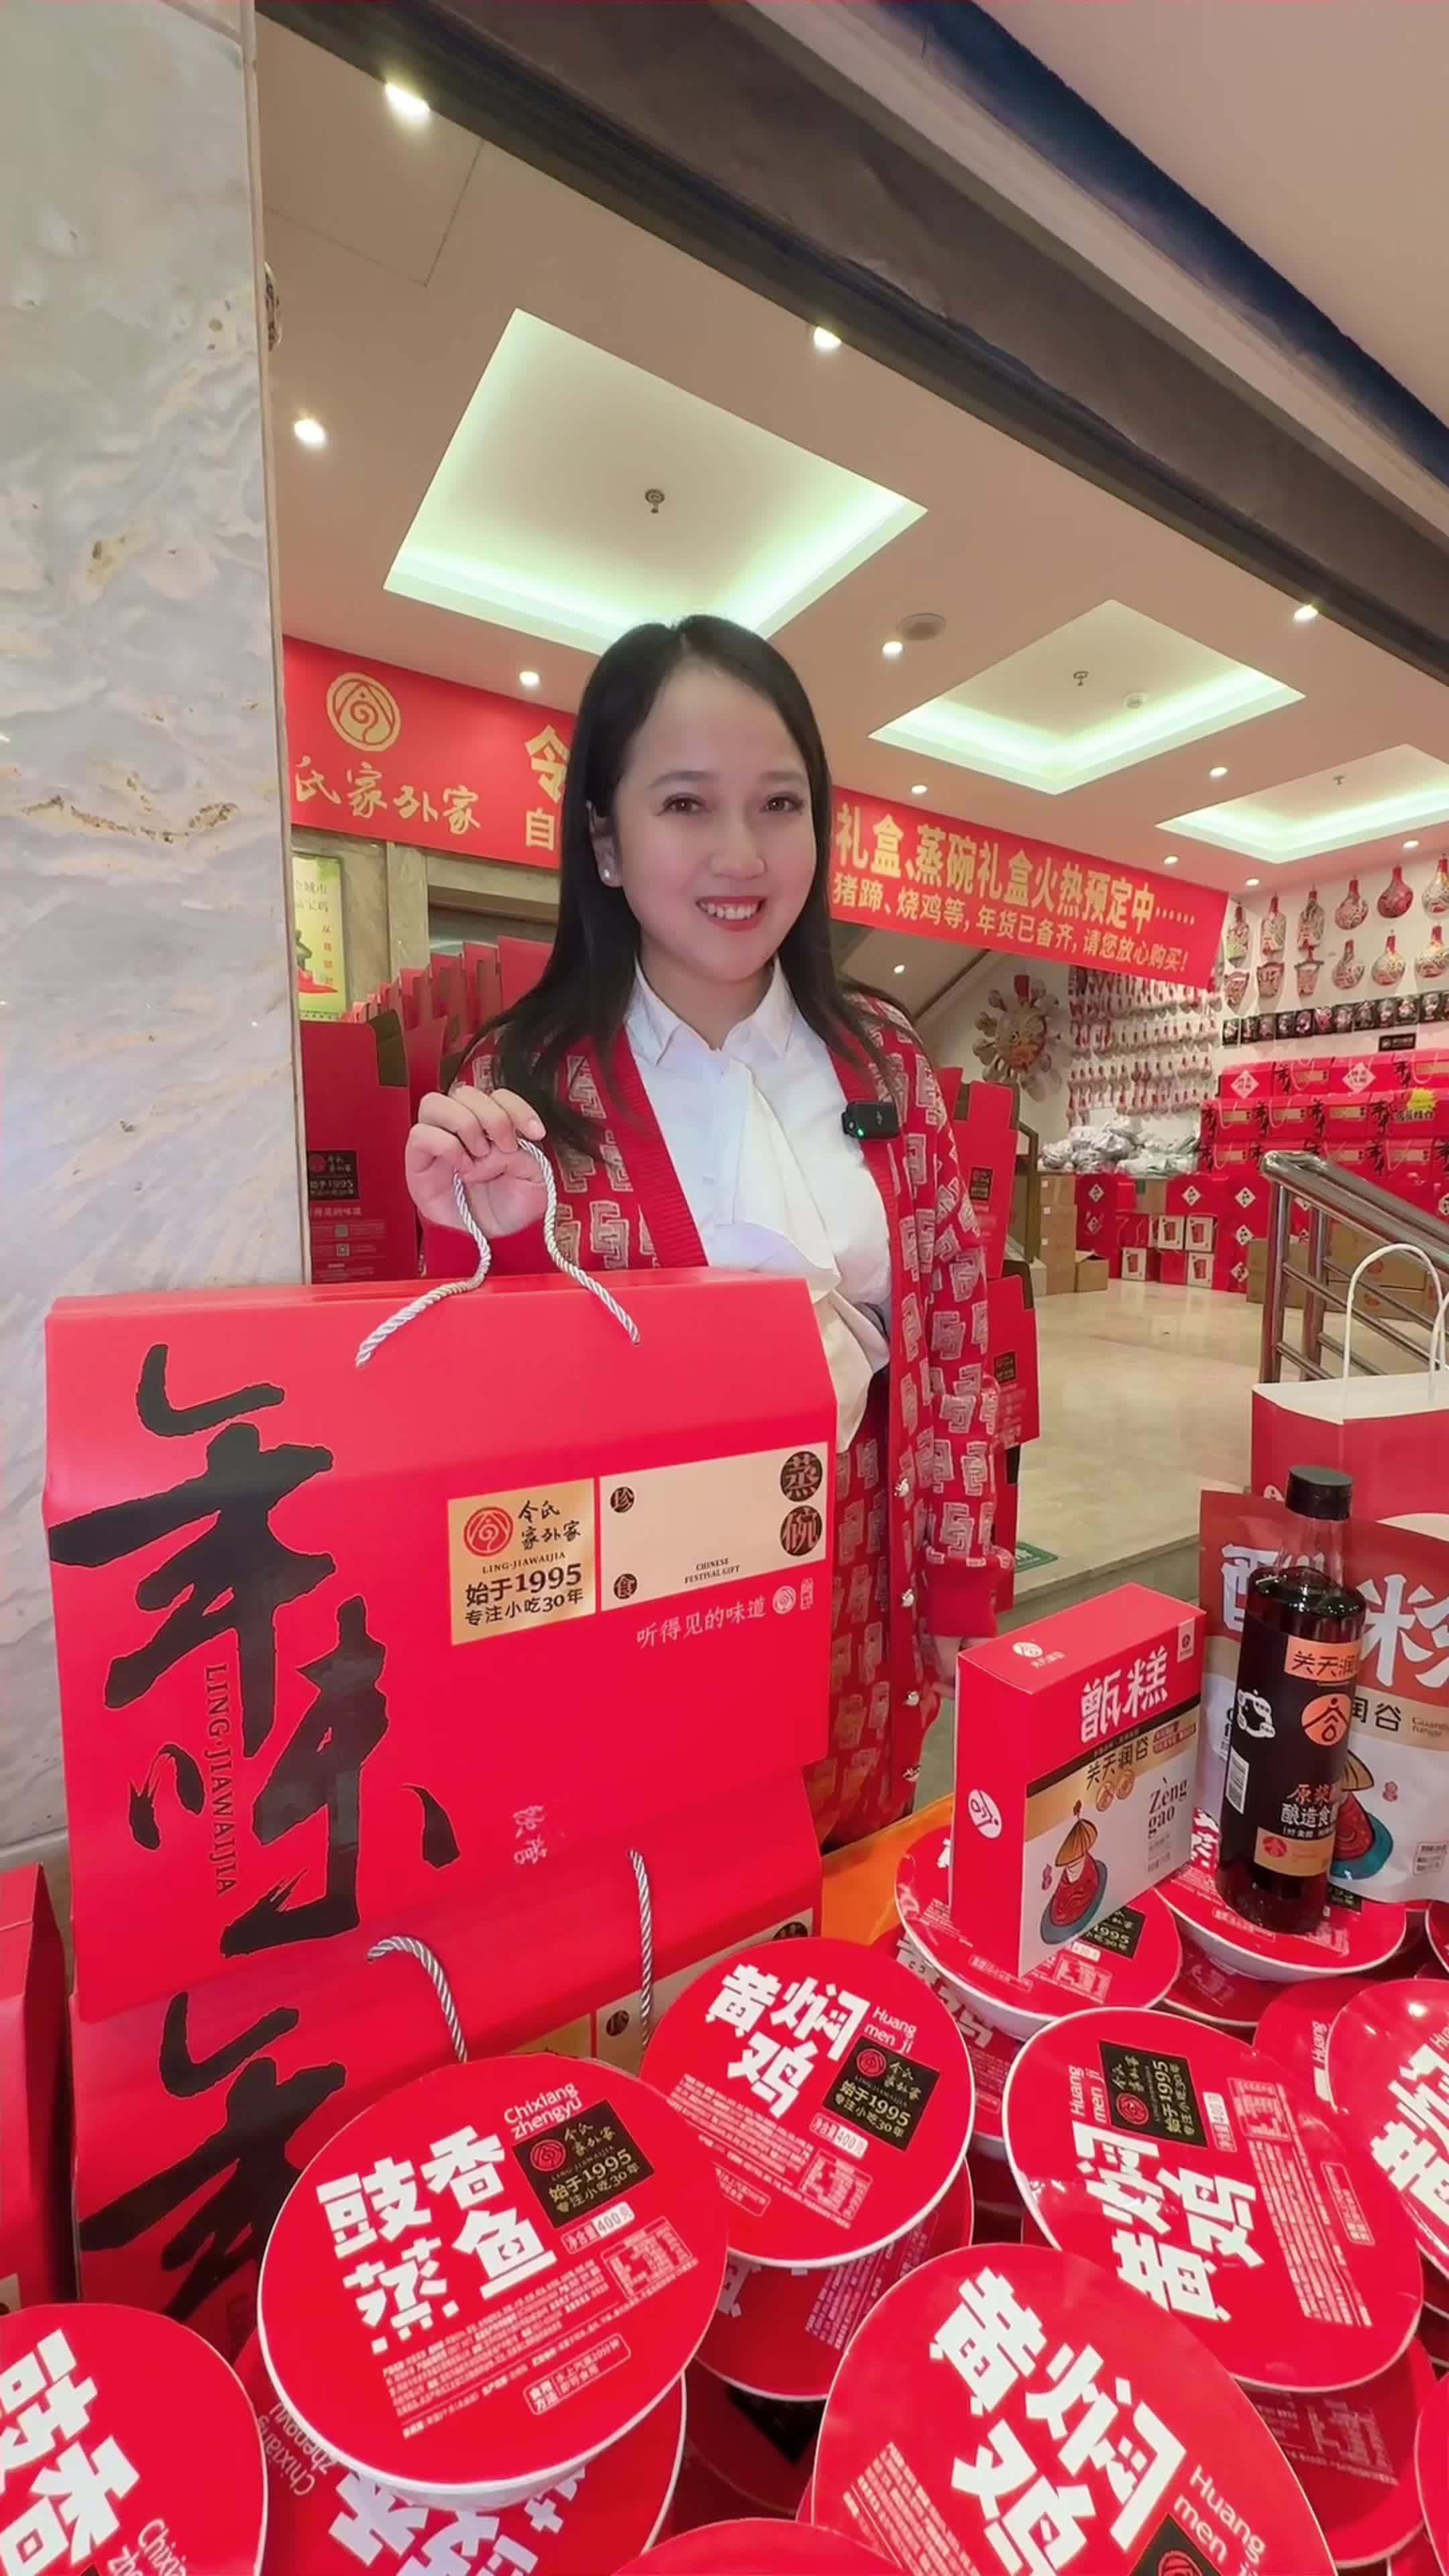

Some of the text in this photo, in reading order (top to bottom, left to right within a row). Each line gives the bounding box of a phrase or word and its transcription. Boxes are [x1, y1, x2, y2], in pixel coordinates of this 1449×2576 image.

[525, 809, 555, 851] 自
[780, 1450, 823, 1557] 蒸碗
[464, 1588, 584, 1627] 专注小吃30年
[466, 1563, 582, 1606] 始于1995
[636, 1597, 766, 1649] 听得见的味道
[1079, 1646, 1169, 1744] 甑糕
[1149, 1776, 1187, 1814] Zèng
[1148, 1805, 1175, 1839] gao
[705, 1964, 871, 2061] 黄焖
[873, 2006, 918, 2039] Huang
[864, 2023, 914, 2055] men ji
[727, 2031, 819, 2119] 鸡
[1068, 2064, 1085, 2116] Huang
[504, 2082, 579, 2125] Chixiang
[511, 2096, 582, 2140] zhengyu
[1090, 2086, 1108, 2123] men
[316, 2125, 505, 2259] 豉香
[549, 2148, 632, 2202] 始于1995
[1155, 2167, 1265, 2268] 鸡
[343, 2208, 557, 2355] 蒸鱼
[929, 2266, 1187, 2551] 黄焖
[1174, 2494, 1228, 2564] men
[1189, 2464, 1267, 2566] Huang
